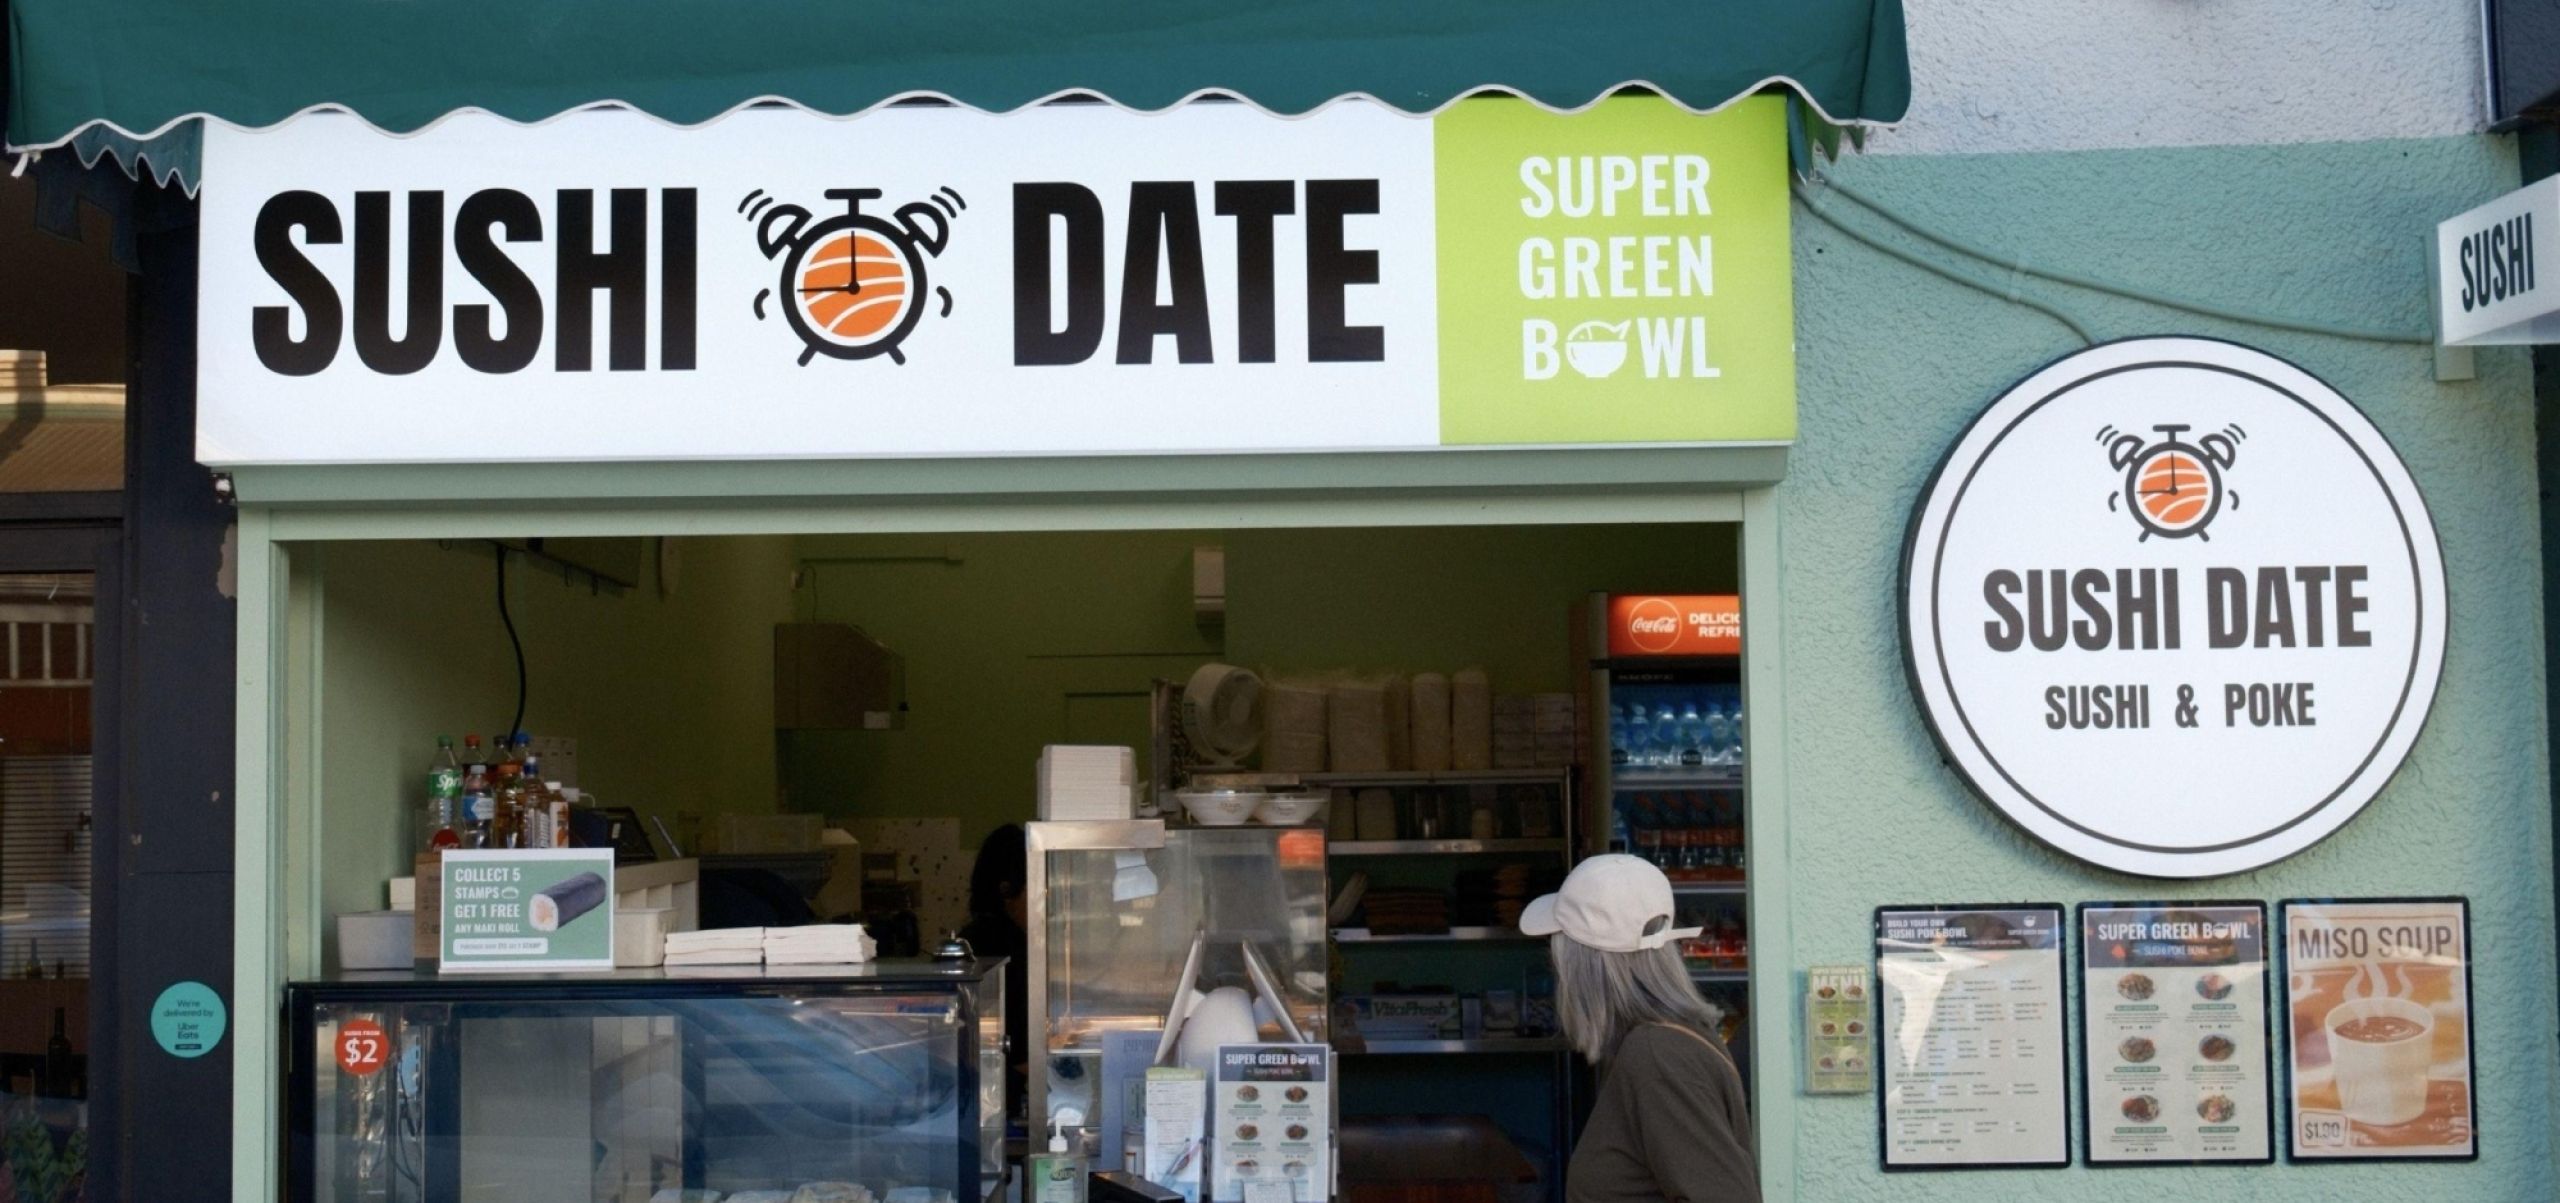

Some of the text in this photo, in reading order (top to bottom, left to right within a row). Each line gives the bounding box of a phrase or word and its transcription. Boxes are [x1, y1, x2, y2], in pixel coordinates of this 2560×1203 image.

[1519, 154, 1712, 218] SUPER
[1519, 236, 1714, 299] GREEN
[2460, 212, 2535, 312] SUSHI
[252, 179, 1385, 376] SUSHI DATE
[1983, 565, 2372, 652] SUSHI DATE
[2044, 682, 2316, 729] SUSHI & POKE
[455, 868, 521, 882] COLLECT 5
[455, 886, 500, 899] STAMPS
[455, 903, 520, 918] GET 1 FREE
[1887, 928, 1915, 939] SUSHI
[1942, 927, 1968, 938] BOWL
[2098, 922, 2146, 940] SUPER
[2152, 922, 2198, 939] GREEN
[2299, 926, 2451, 959] MISO SOUP
[163, 1009, 214, 1018] delivered by
[177, 1022, 199, 1031] Uber
[177, 1031, 199, 1040] Eats
[345, 1037, 378, 1067] $2
[1225, 1053, 1256, 1065] SUPER
[1258, 1053, 1288, 1064] GREEN
